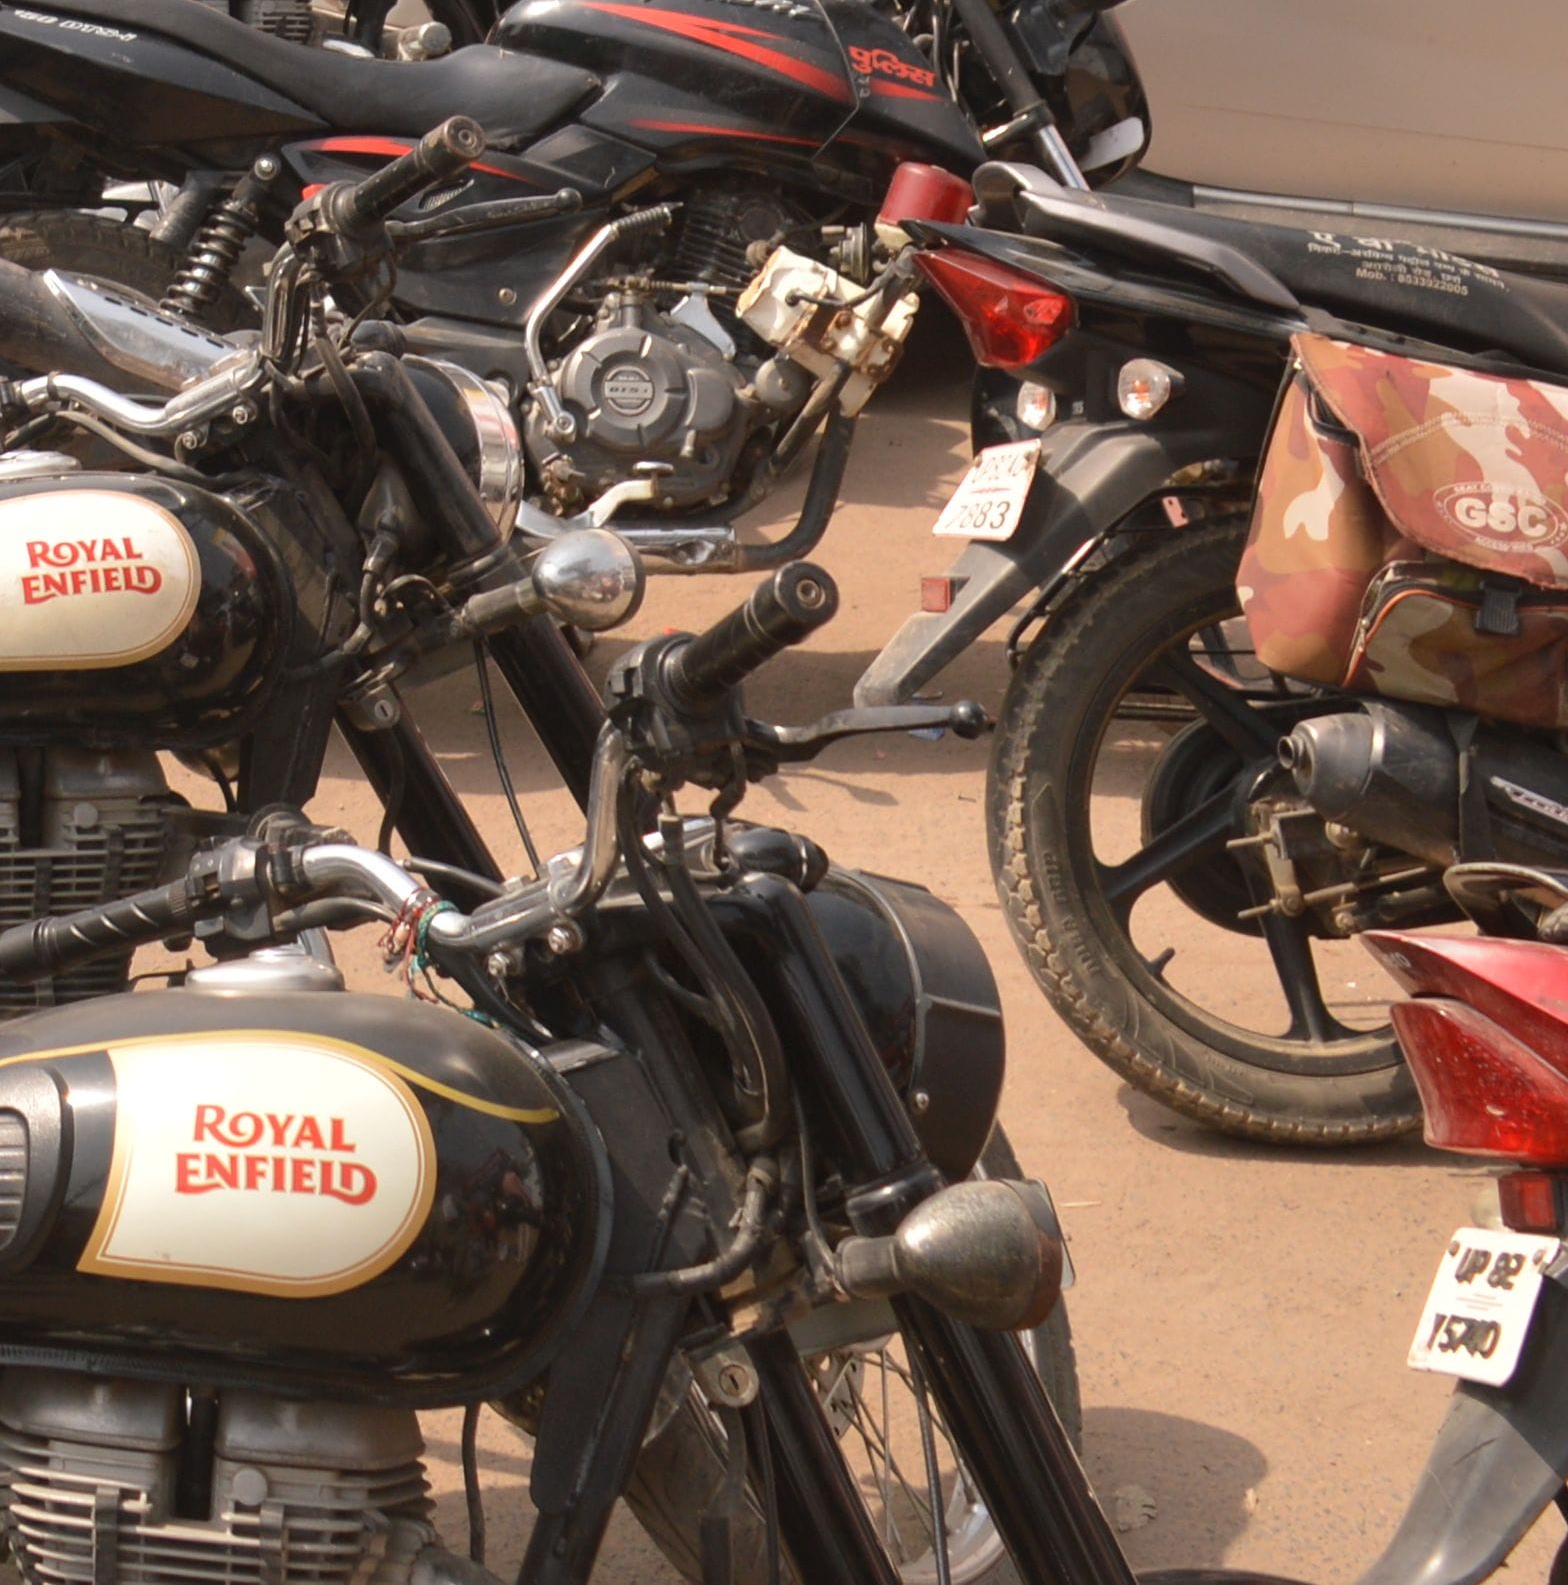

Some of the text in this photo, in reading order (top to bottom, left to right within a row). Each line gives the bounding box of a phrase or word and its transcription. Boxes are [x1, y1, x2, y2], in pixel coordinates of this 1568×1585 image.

[848, 46, 937, 88] पुलिस
[1454, 497, 1548, 537] GSC
[26, 536, 143, 567] ROYAL
[21, 564, 162, 605] ENFIELD
[192, 1104, 358, 1153] ROYAL
[174, 1153, 377, 1205] ENFIELD
[1454, 1246, 1527, 1291] UP 82
